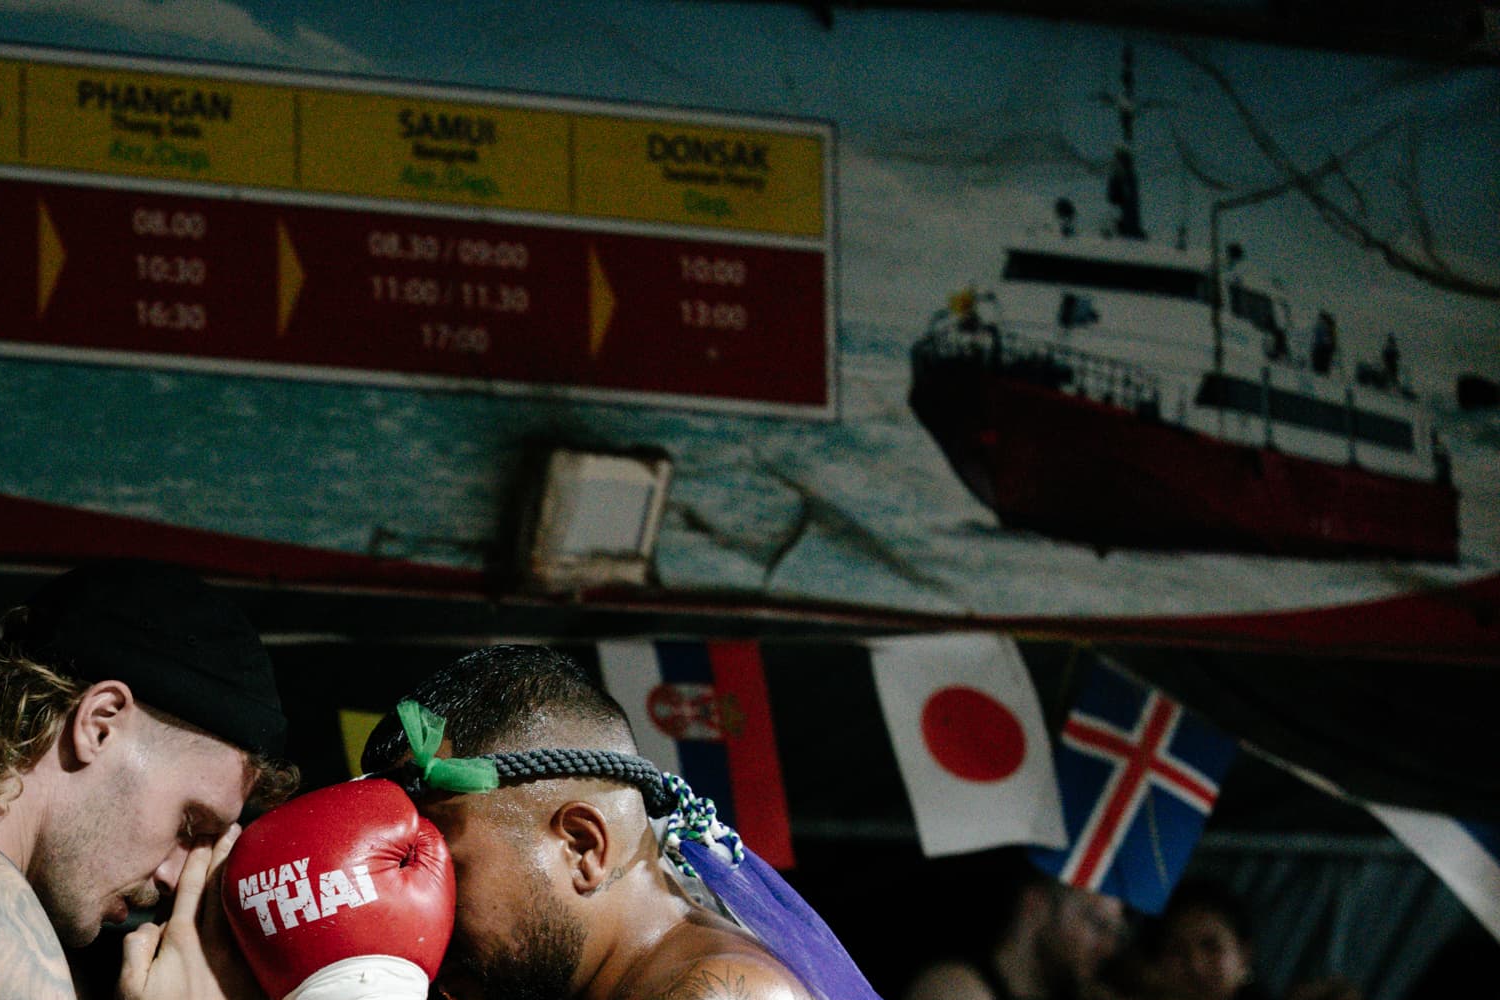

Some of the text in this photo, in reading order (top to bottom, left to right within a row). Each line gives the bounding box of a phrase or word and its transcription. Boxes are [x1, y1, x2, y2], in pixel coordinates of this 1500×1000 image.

[77, 80, 232, 120] PHANGAN
[398, 109, 497, 144] SAMUI
[646, 132, 770, 171] DONSAK
[237, 856, 311, 900] MUAY
[241, 865, 379, 937] THAI
